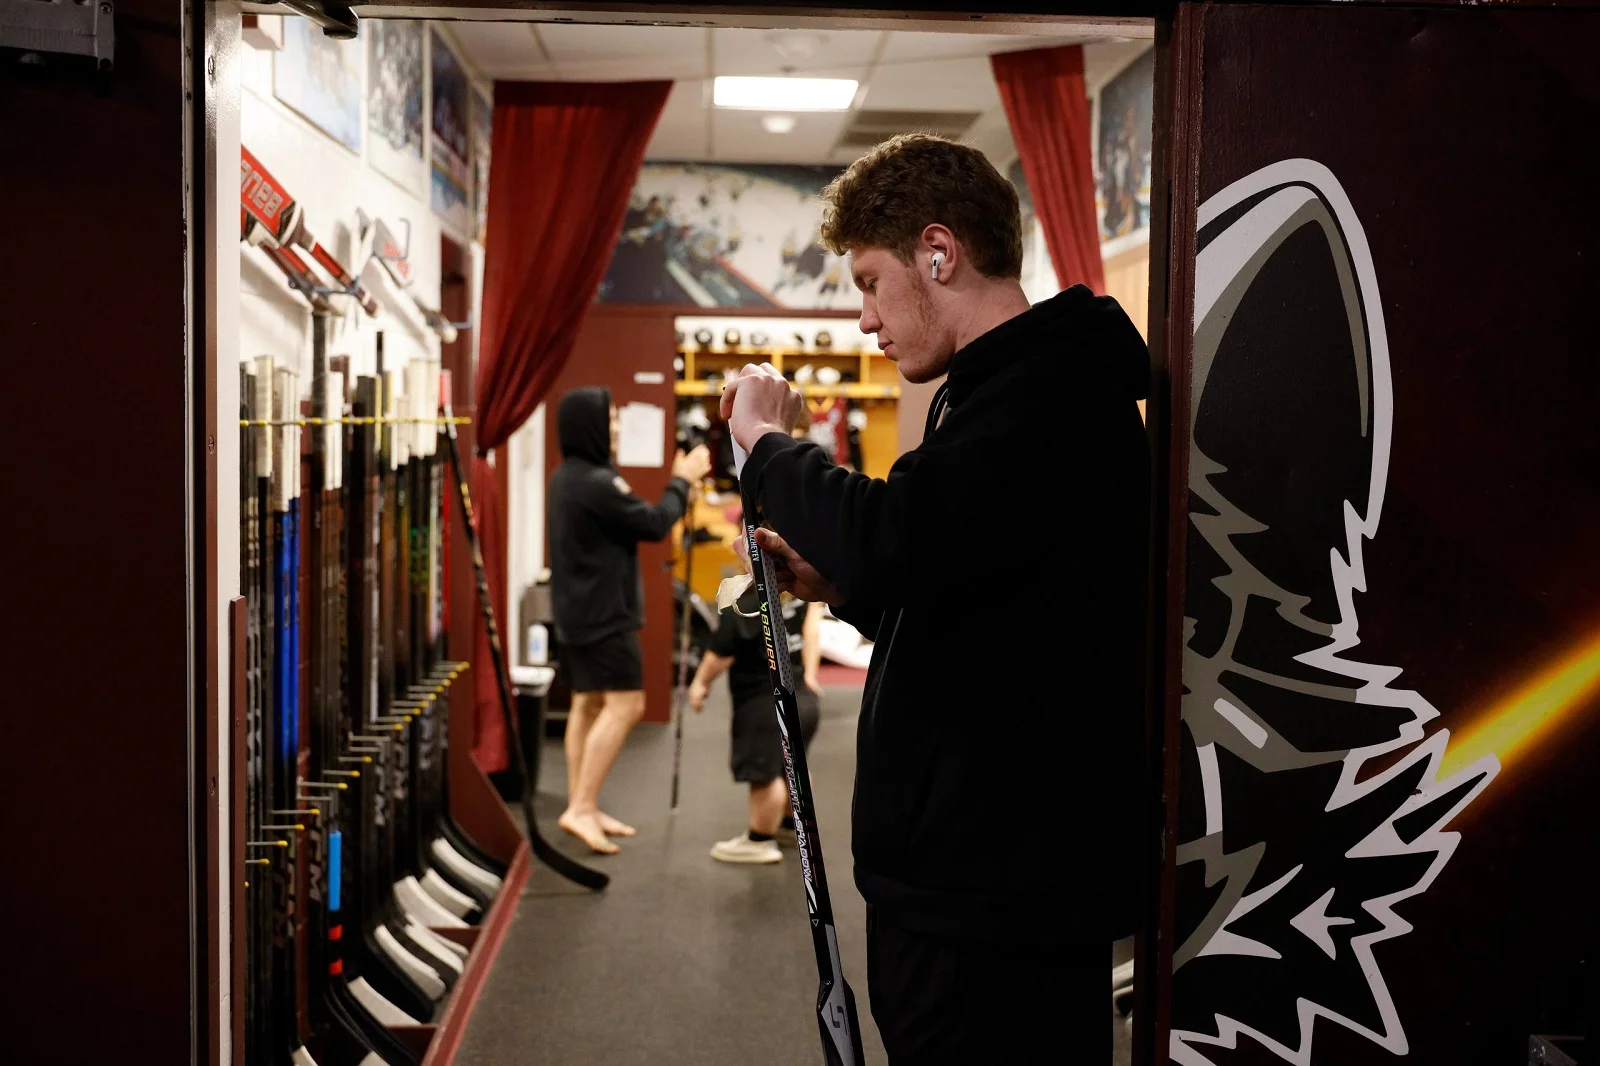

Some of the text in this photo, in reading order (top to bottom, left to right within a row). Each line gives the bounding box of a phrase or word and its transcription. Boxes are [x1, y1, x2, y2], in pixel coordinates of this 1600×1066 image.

[240, 159, 283, 218] BAUE
[762, 614, 777, 671] BAUER
[794, 819, 813, 883] SHADOW
